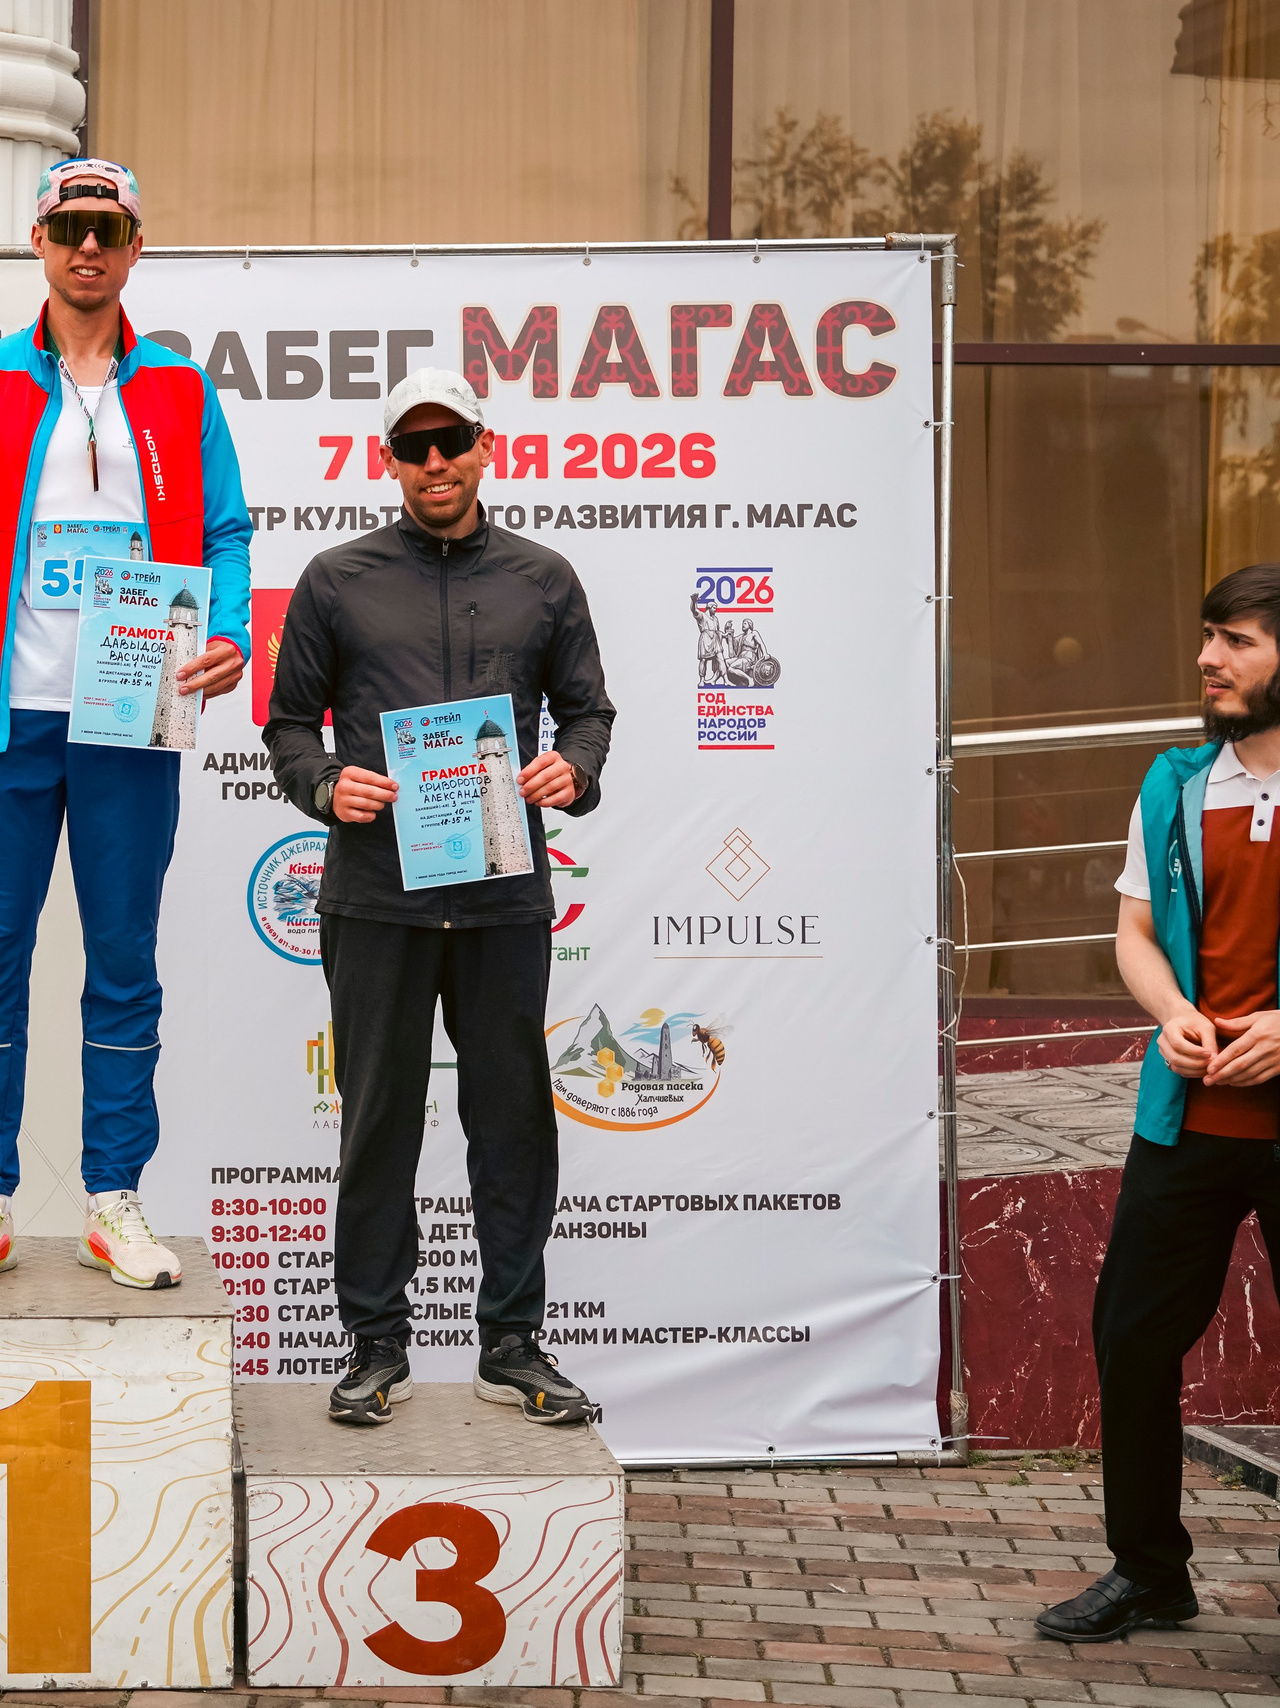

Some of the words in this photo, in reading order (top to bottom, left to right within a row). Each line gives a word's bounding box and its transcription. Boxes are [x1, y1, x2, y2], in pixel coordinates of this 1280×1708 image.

[460, 300, 898, 399] МАГАС
[142, 429, 166, 501] NORDSKI
[319, 435, 353, 480] 7
[563, 432, 716, 479] 2026
[534, 503, 707, 529] РАЗВИТИЯ
[715, 503, 740, 529] Г.
[747, 502, 858, 528] МАГАС
[120, 587, 148, 596] ЗАБЕГ
[697, 575, 774, 606] 2026
[120, 595, 159, 607] МАГАС
[110, 625, 175, 641] ГРАМОТА
[100, 636, 167, 654] ДАВЫДОВ
[109, 650, 162, 665] ВАСИЛИЙ
[697, 692, 726, 704] ГОД
[697, 704, 774, 716] ЕДИНСТВА
[697, 717, 767, 729] НАРОДОВ
[422, 730, 450, 740] ЗАБЕГ
[424, 736, 463, 749] МАГАС
[697, 730, 757, 742] РОССИИ
[422, 764, 487, 782] ГРАМОТА
[419, 775, 491, 794] КРИВОРОТОВ
[424, 786, 488, 804] АЛЕКСАНДР
[257, 857, 282, 910] ИСТОЧНИК
[653, 915, 820, 947] IMPULSE
[621, 1083, 664, 1092] Родовая
[666, 1082, 703, 1091] пасека
[566, 1091, 609, 1114] доверяют
[618, 1107, 636, 1118] 1886
[638, 1106, 659, 1117] года
[211, 1198, 326, 1216] 8:30-10:00
[606, 1193, 737, 1213] СТАРТОВЫХ
[743, 1194, 841, 1212] ПАКЕТОВ
[211, 1225, 326, 1242] 9:30-12:40
[460, 1250, 477, 1266] М
[444, 1277, 475, 1293] КМ
[547, 1302, 570, 1319] 21
[574, 1302, 605, 1318] КМ
[602, 1328, 617, 1344] И
[621, 1325, 811, 1345] МАСТЕР-КЛАССЫ
[364, 1501, 506, 1676] 3
